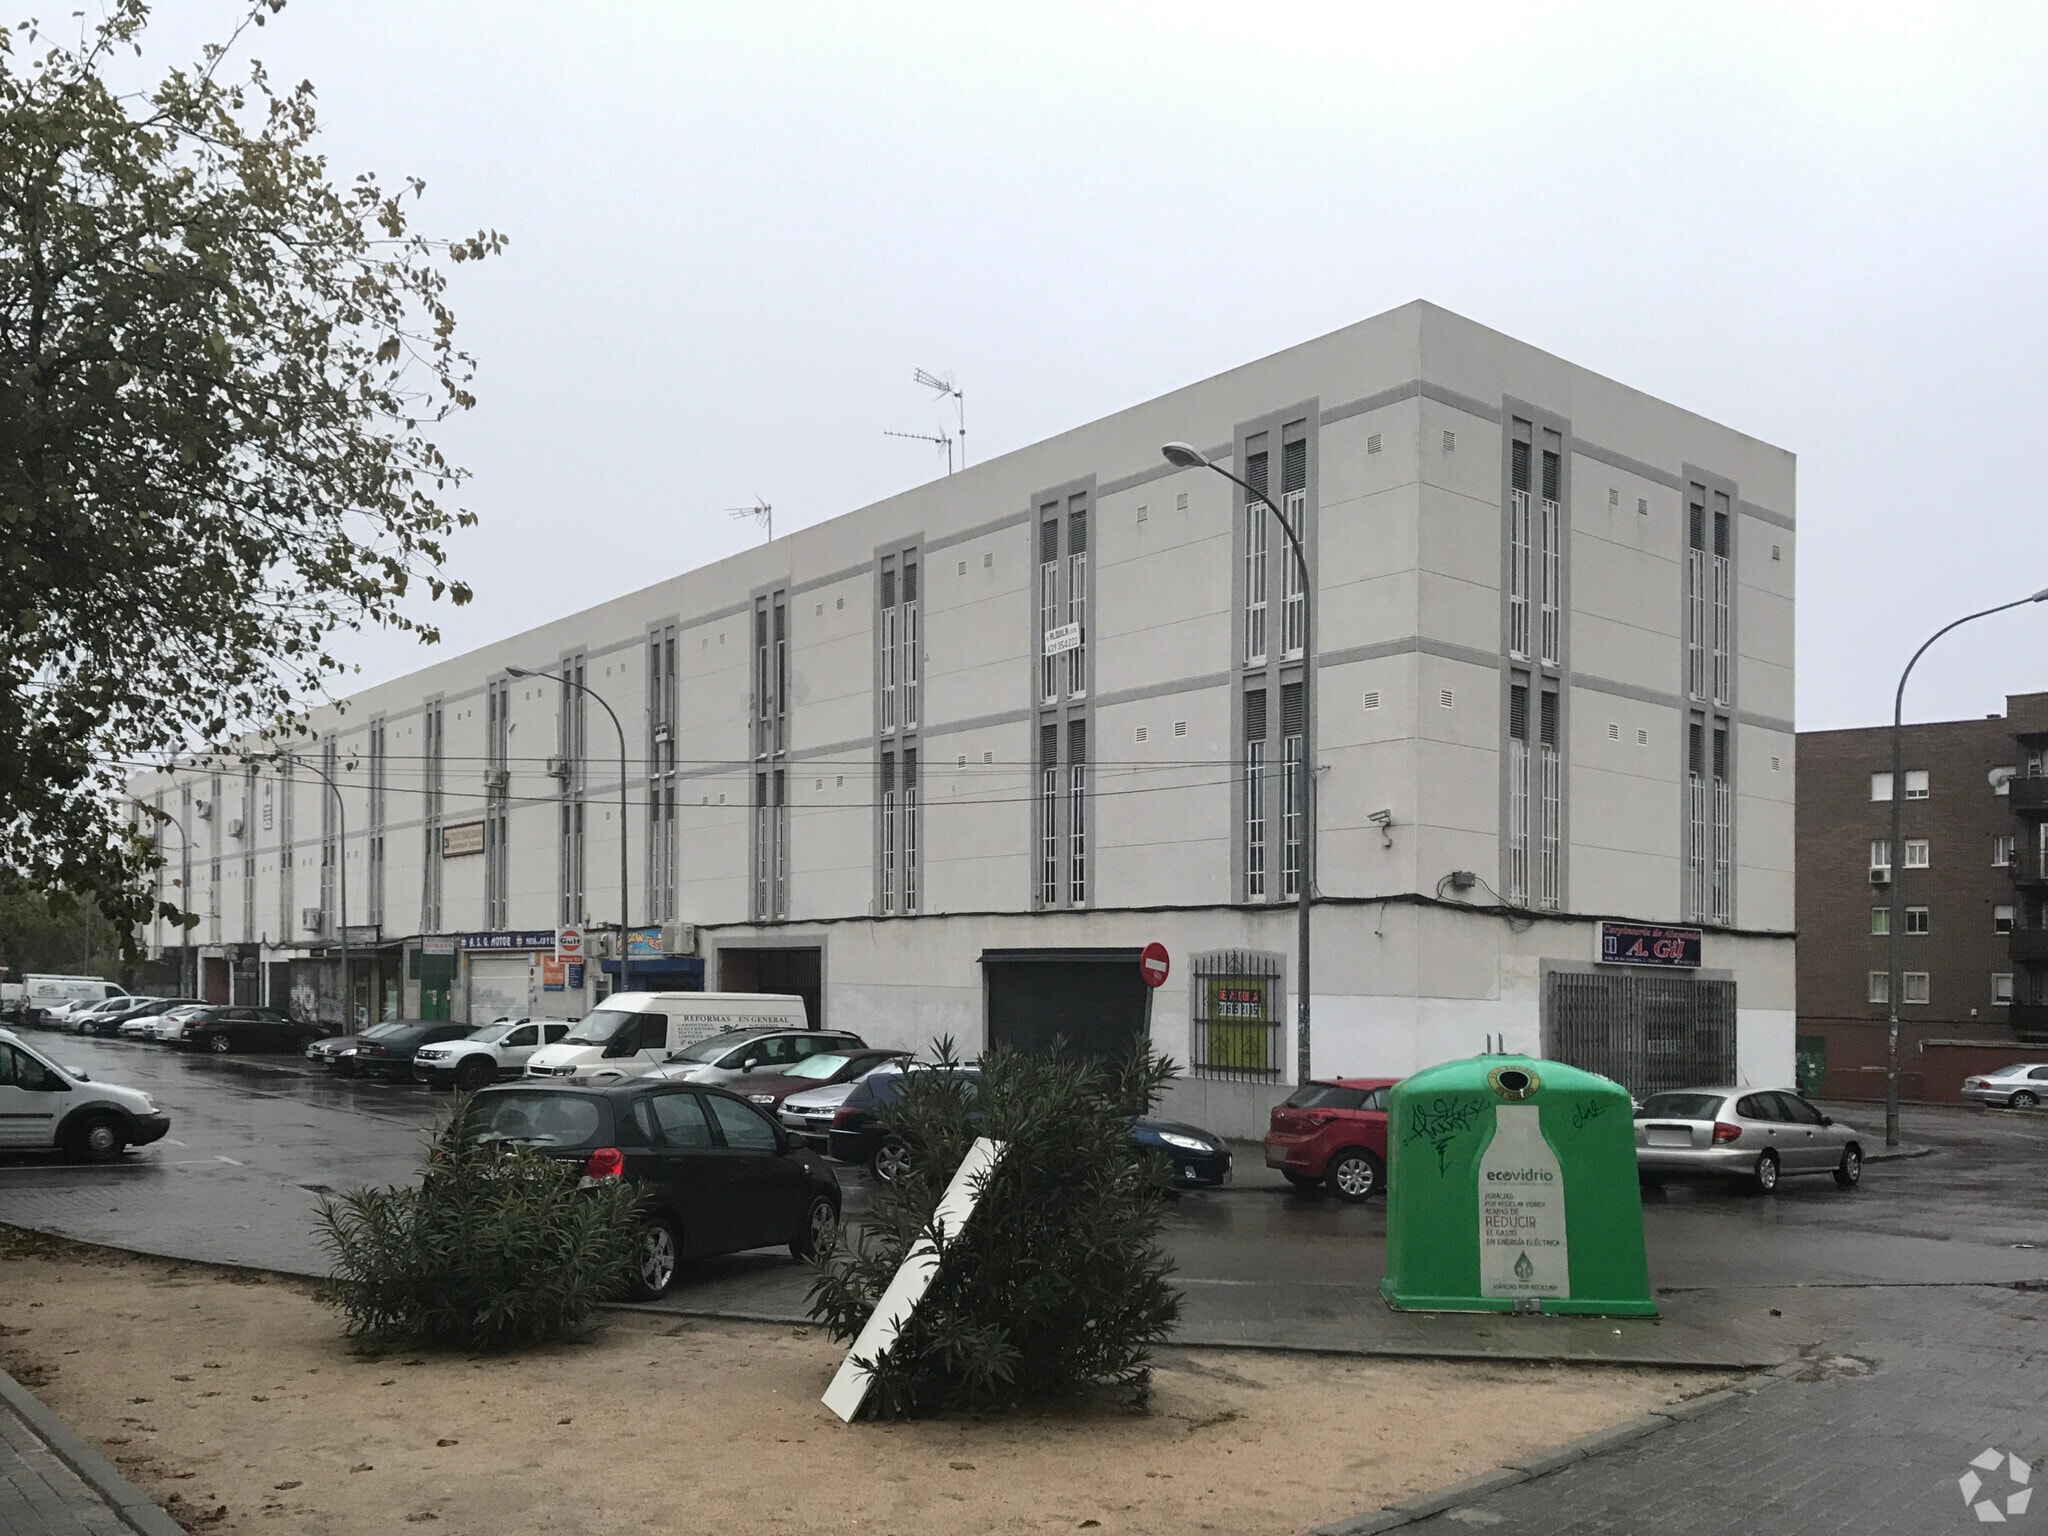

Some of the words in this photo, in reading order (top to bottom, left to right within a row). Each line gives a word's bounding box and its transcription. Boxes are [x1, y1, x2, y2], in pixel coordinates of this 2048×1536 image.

[491, 936, 511, 947] MOTOR
[560, 937, 580, 945] Gulf
[1626, 938, 1649, 957] A.
[1653, 938, 1685, 959] Gil
[1487, 1168, 1554, 1181] ecovidrio
[1485, 1216, 1536, 1228] REDUCIR
[1526, 1238, 1560, 1246] ELÉCTRICA
